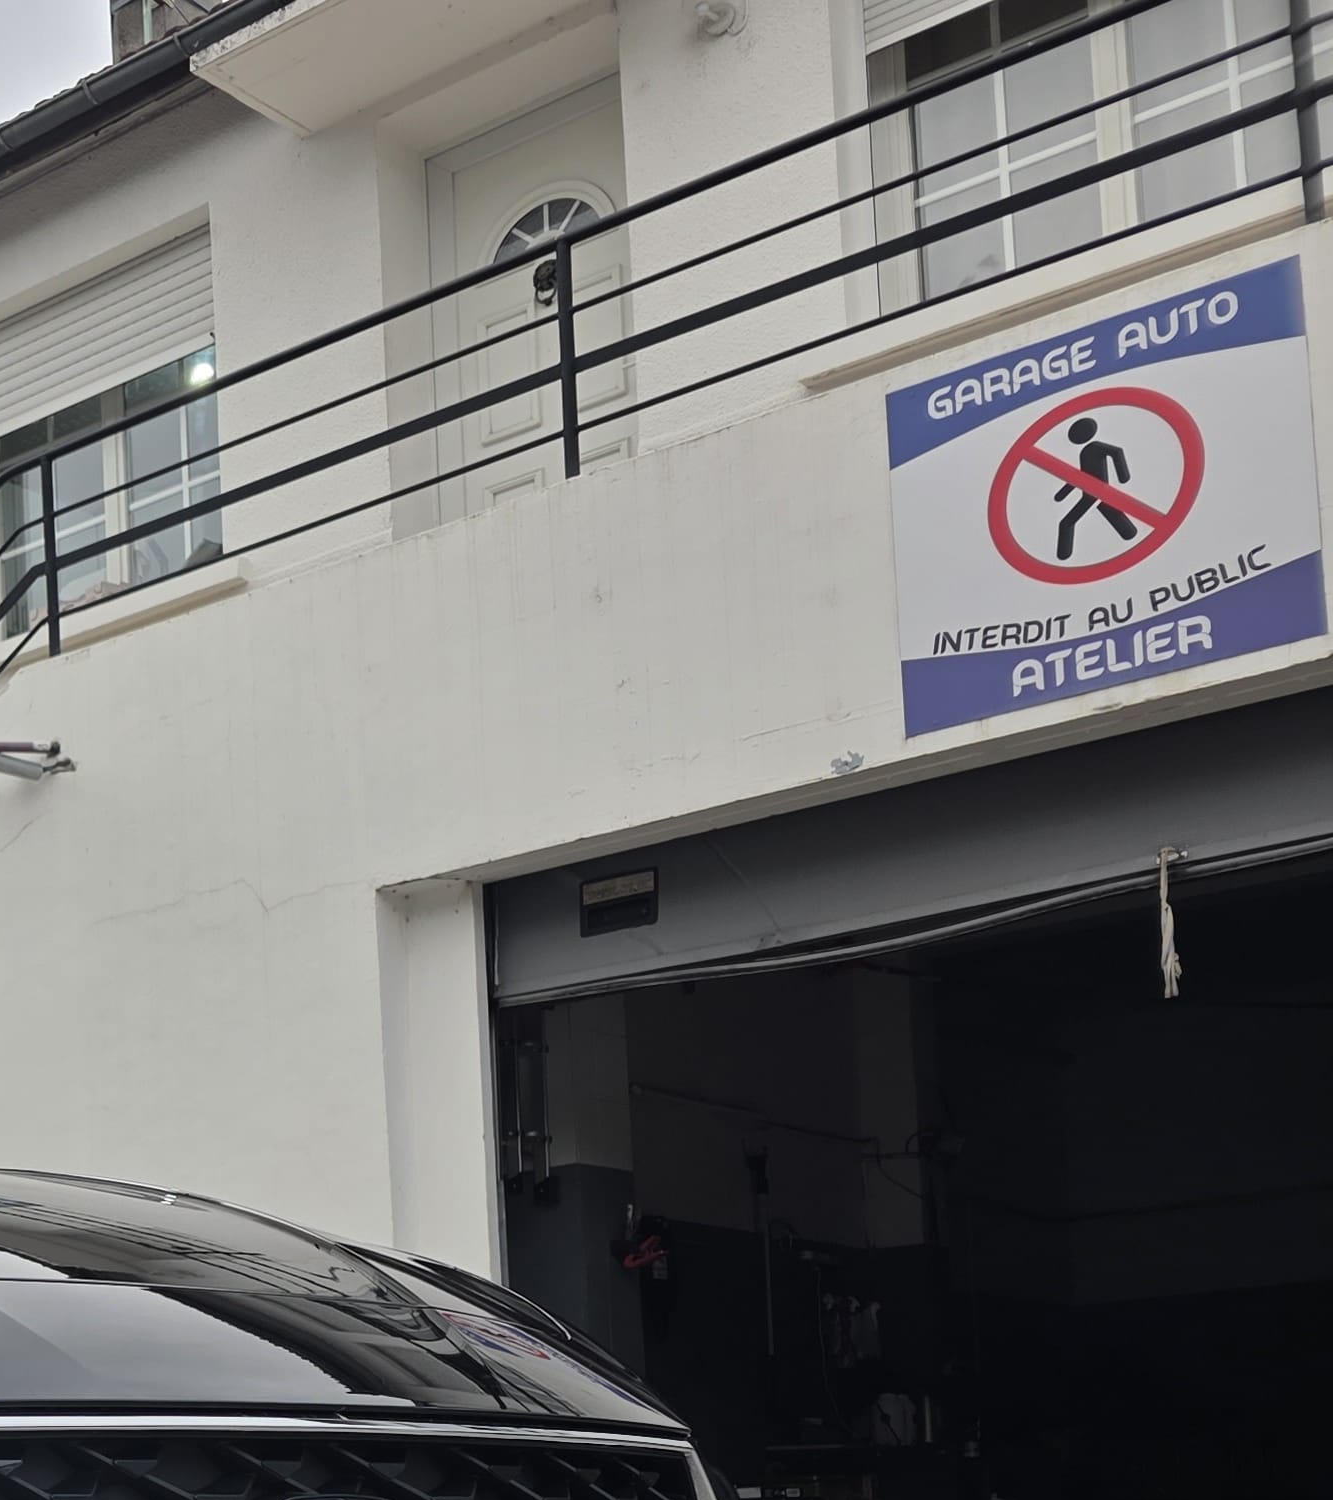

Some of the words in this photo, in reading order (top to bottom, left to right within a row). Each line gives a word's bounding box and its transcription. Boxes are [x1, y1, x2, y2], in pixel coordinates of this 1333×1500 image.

[926, 335, 1098, 420] GARAGE
[1117, 290, 1240, 359] AUTO
[932, 613, 1072, 656] INTERDIT
[1087, 597, 1134, 633] AU
[1149, 543, 1273, 613] PUBLIC
[1011, 615, 1214, 698] ATELIER
